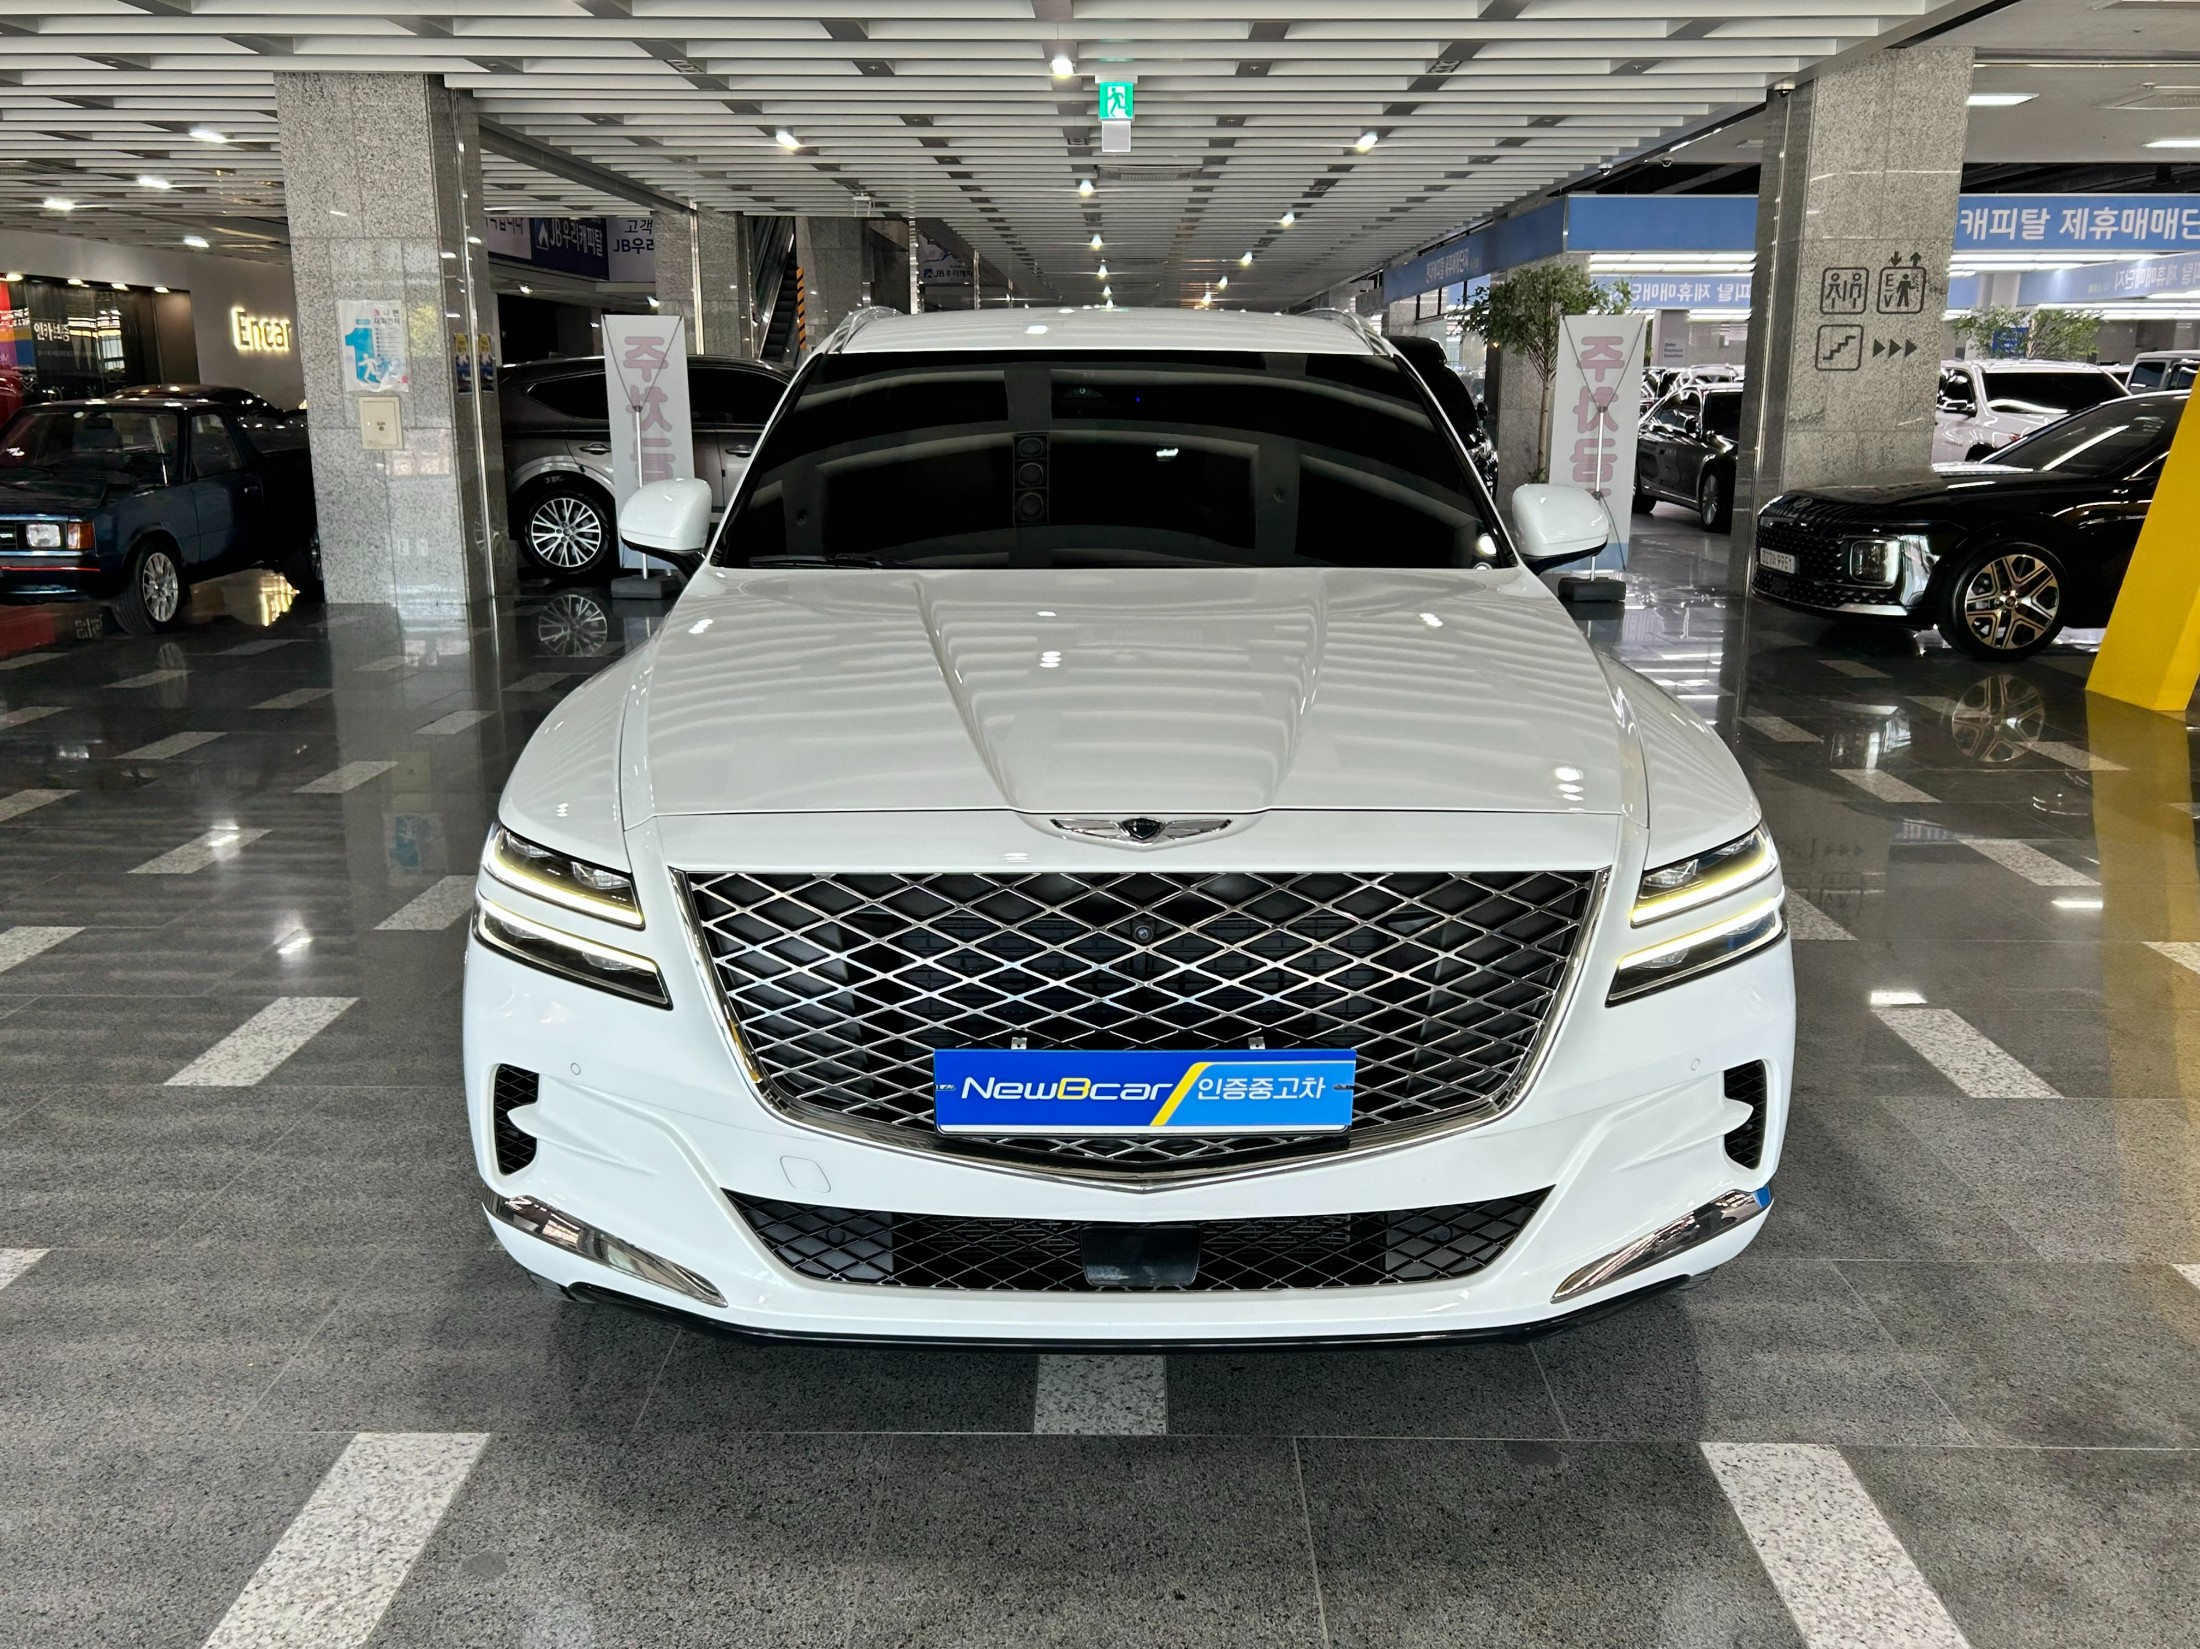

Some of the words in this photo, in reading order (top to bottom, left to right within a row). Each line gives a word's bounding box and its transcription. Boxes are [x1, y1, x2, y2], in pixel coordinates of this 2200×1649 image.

[1959, 207, 2051, 241] 캐피탈
[231, 307, 291, 352] Encar
[961, 1077, 1172, 1100] NewBcar
[1197, 1077, 1326, 1100] 인증중고차
